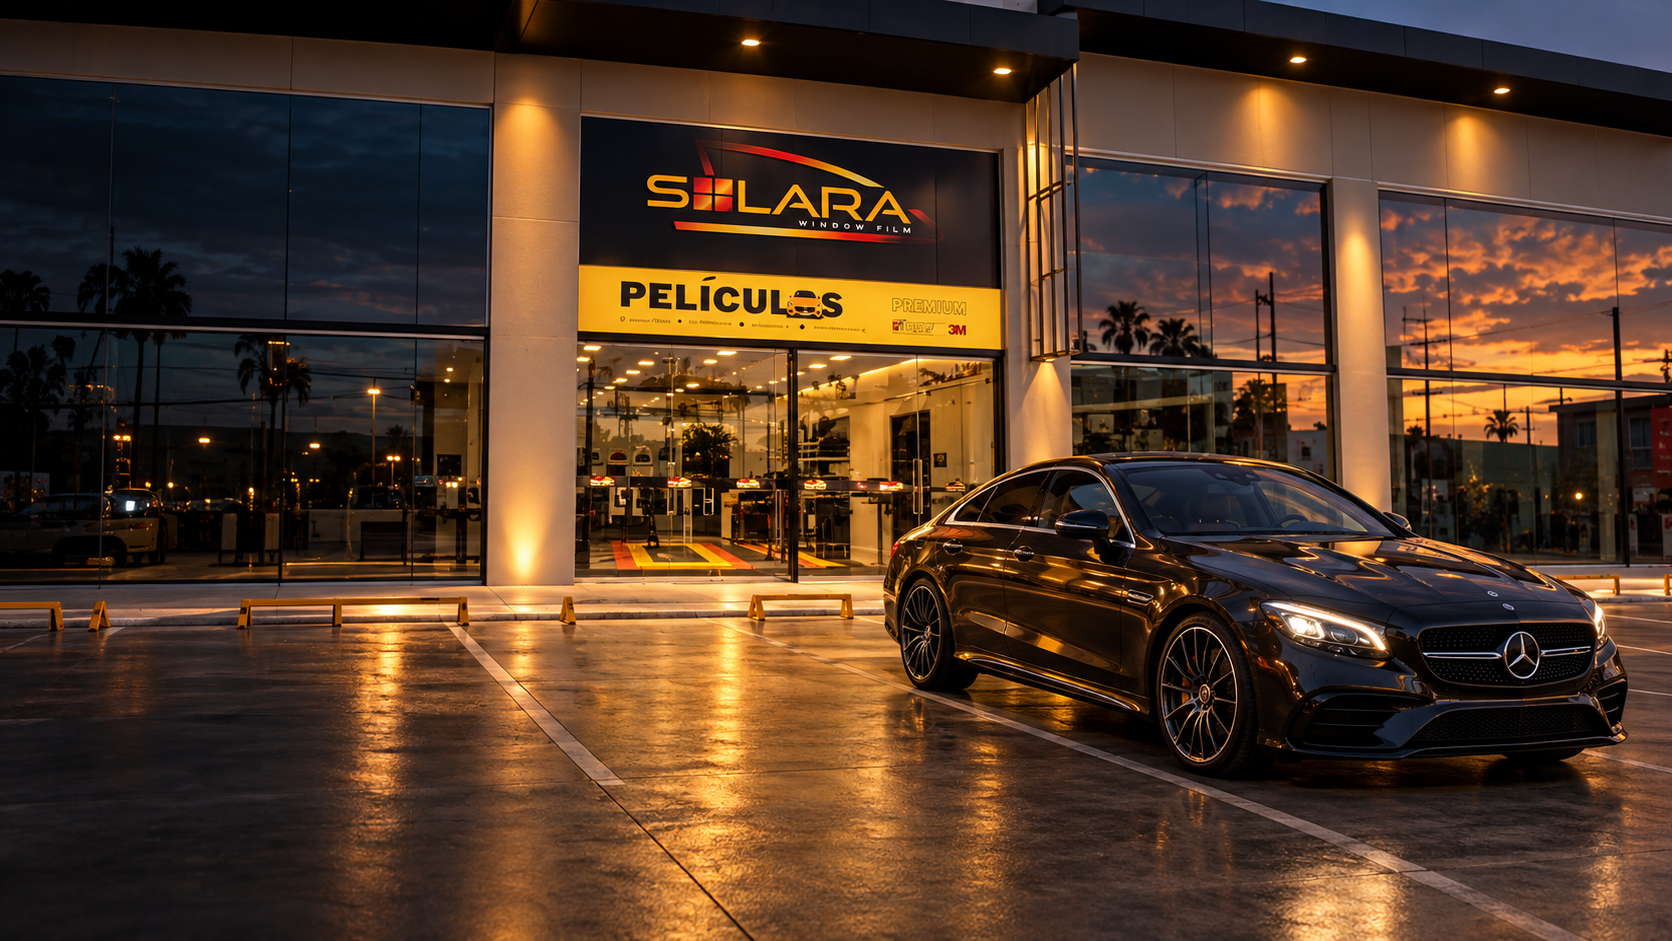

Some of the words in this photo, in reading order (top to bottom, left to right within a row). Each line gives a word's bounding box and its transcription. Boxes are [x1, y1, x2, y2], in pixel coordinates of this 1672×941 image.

[798, 220, 865, 231] WINDOW
[877, 225, 912, 234] FILM
[620, 276, 843, 318] PELÍCULS
[892, 297, 967, 316] PREMIUM
[948, 324, 966, 336] 3M
